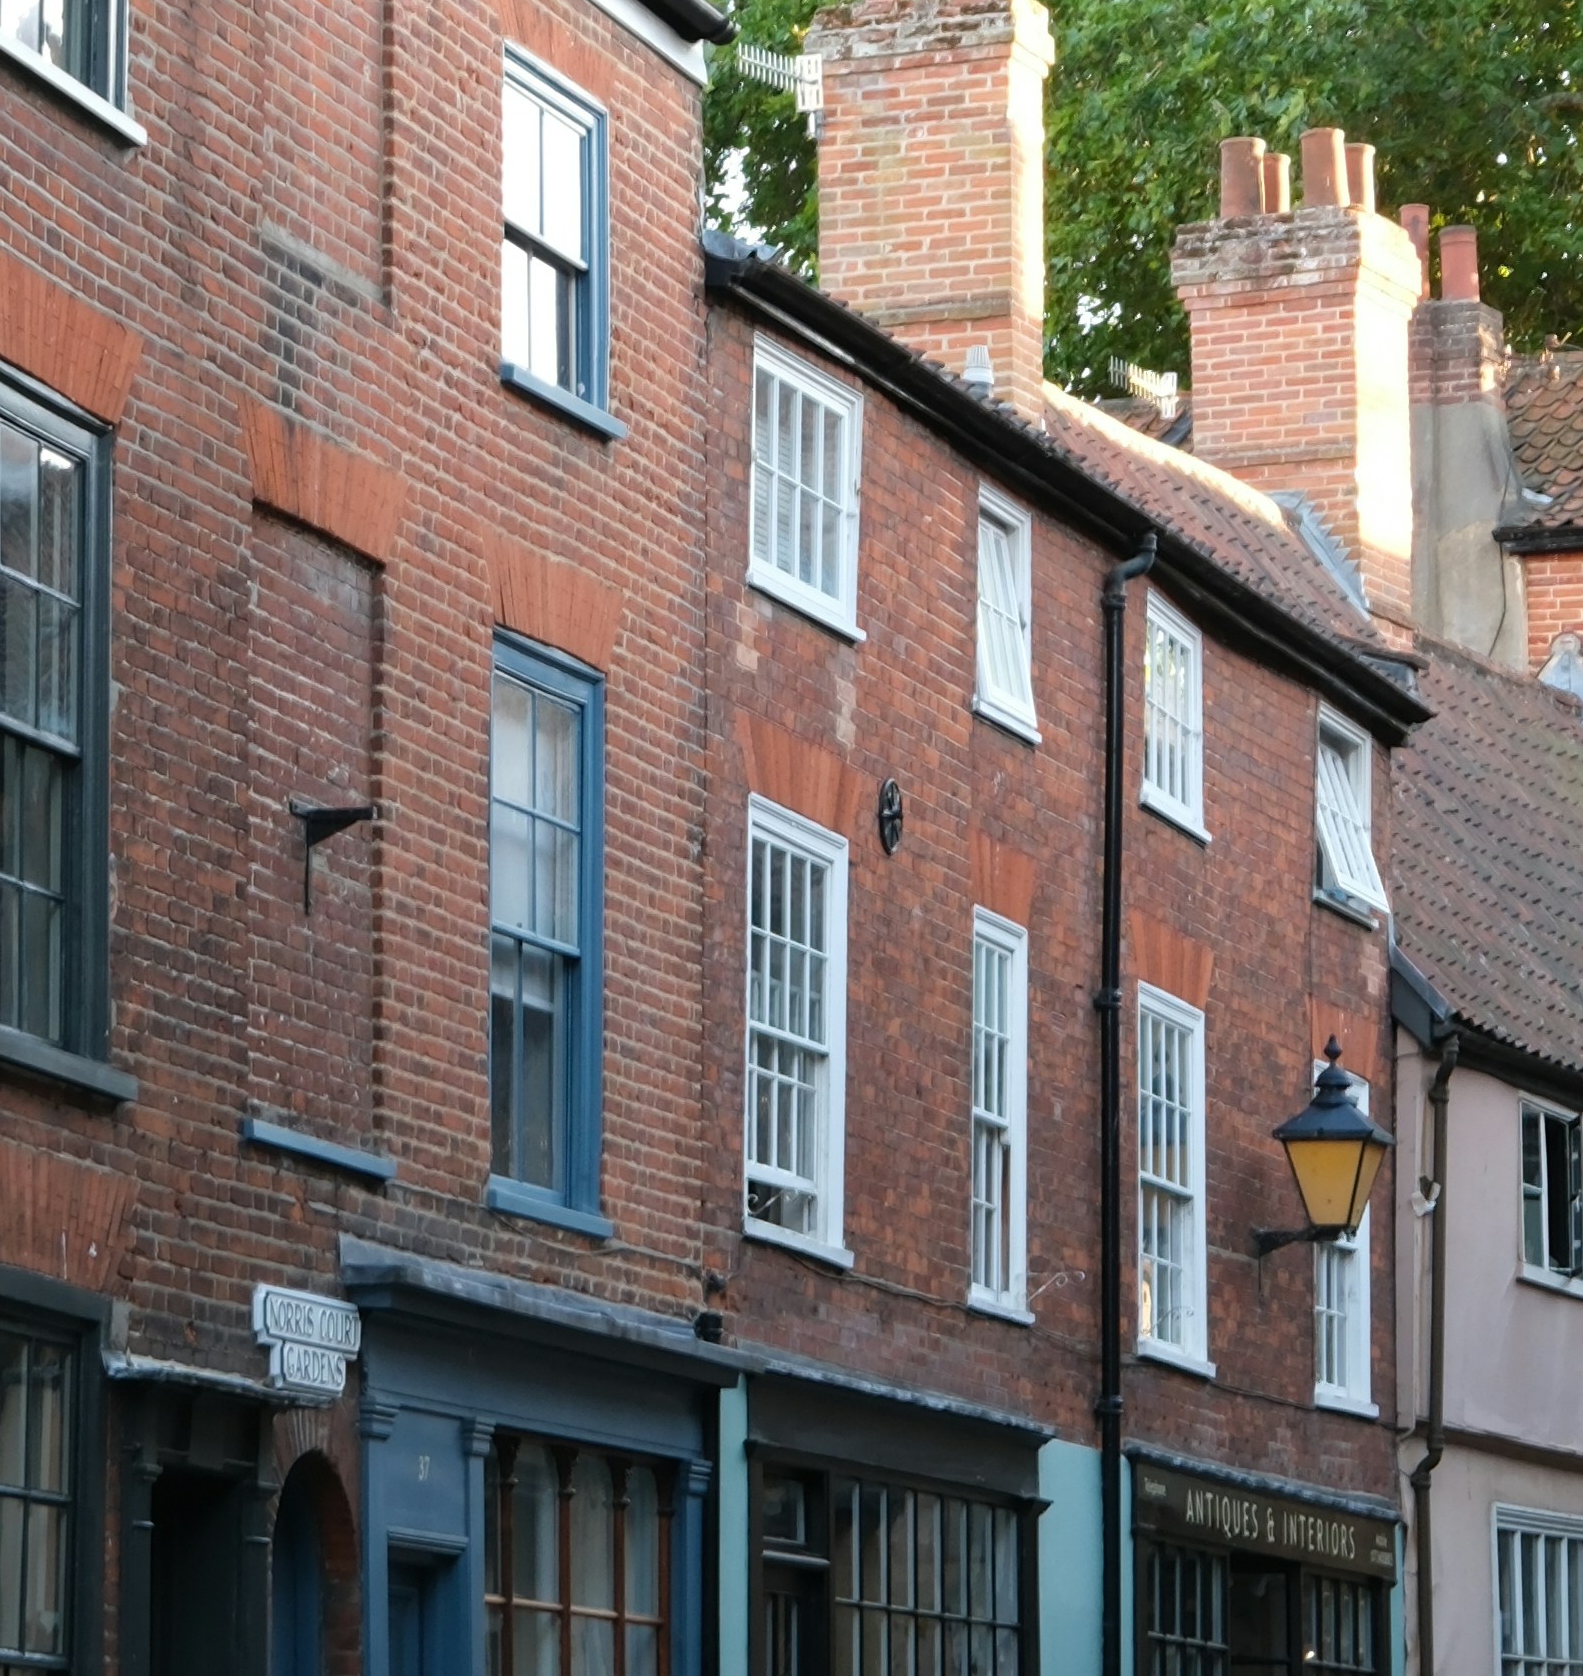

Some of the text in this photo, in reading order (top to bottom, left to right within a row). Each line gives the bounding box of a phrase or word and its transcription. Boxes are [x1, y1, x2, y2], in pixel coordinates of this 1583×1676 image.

[269, 1298, 359, 1347] NORRIS COURT
[286, 1345, 344, 1387] GARDENS
[418, 1455, 431, 1482] 37
[1186, 1488, 1259, 1540] ANTIQUES
[1266, 1506, 1275, 1543] &
[1283, 1511, 1356, 1560] INTERIORS
